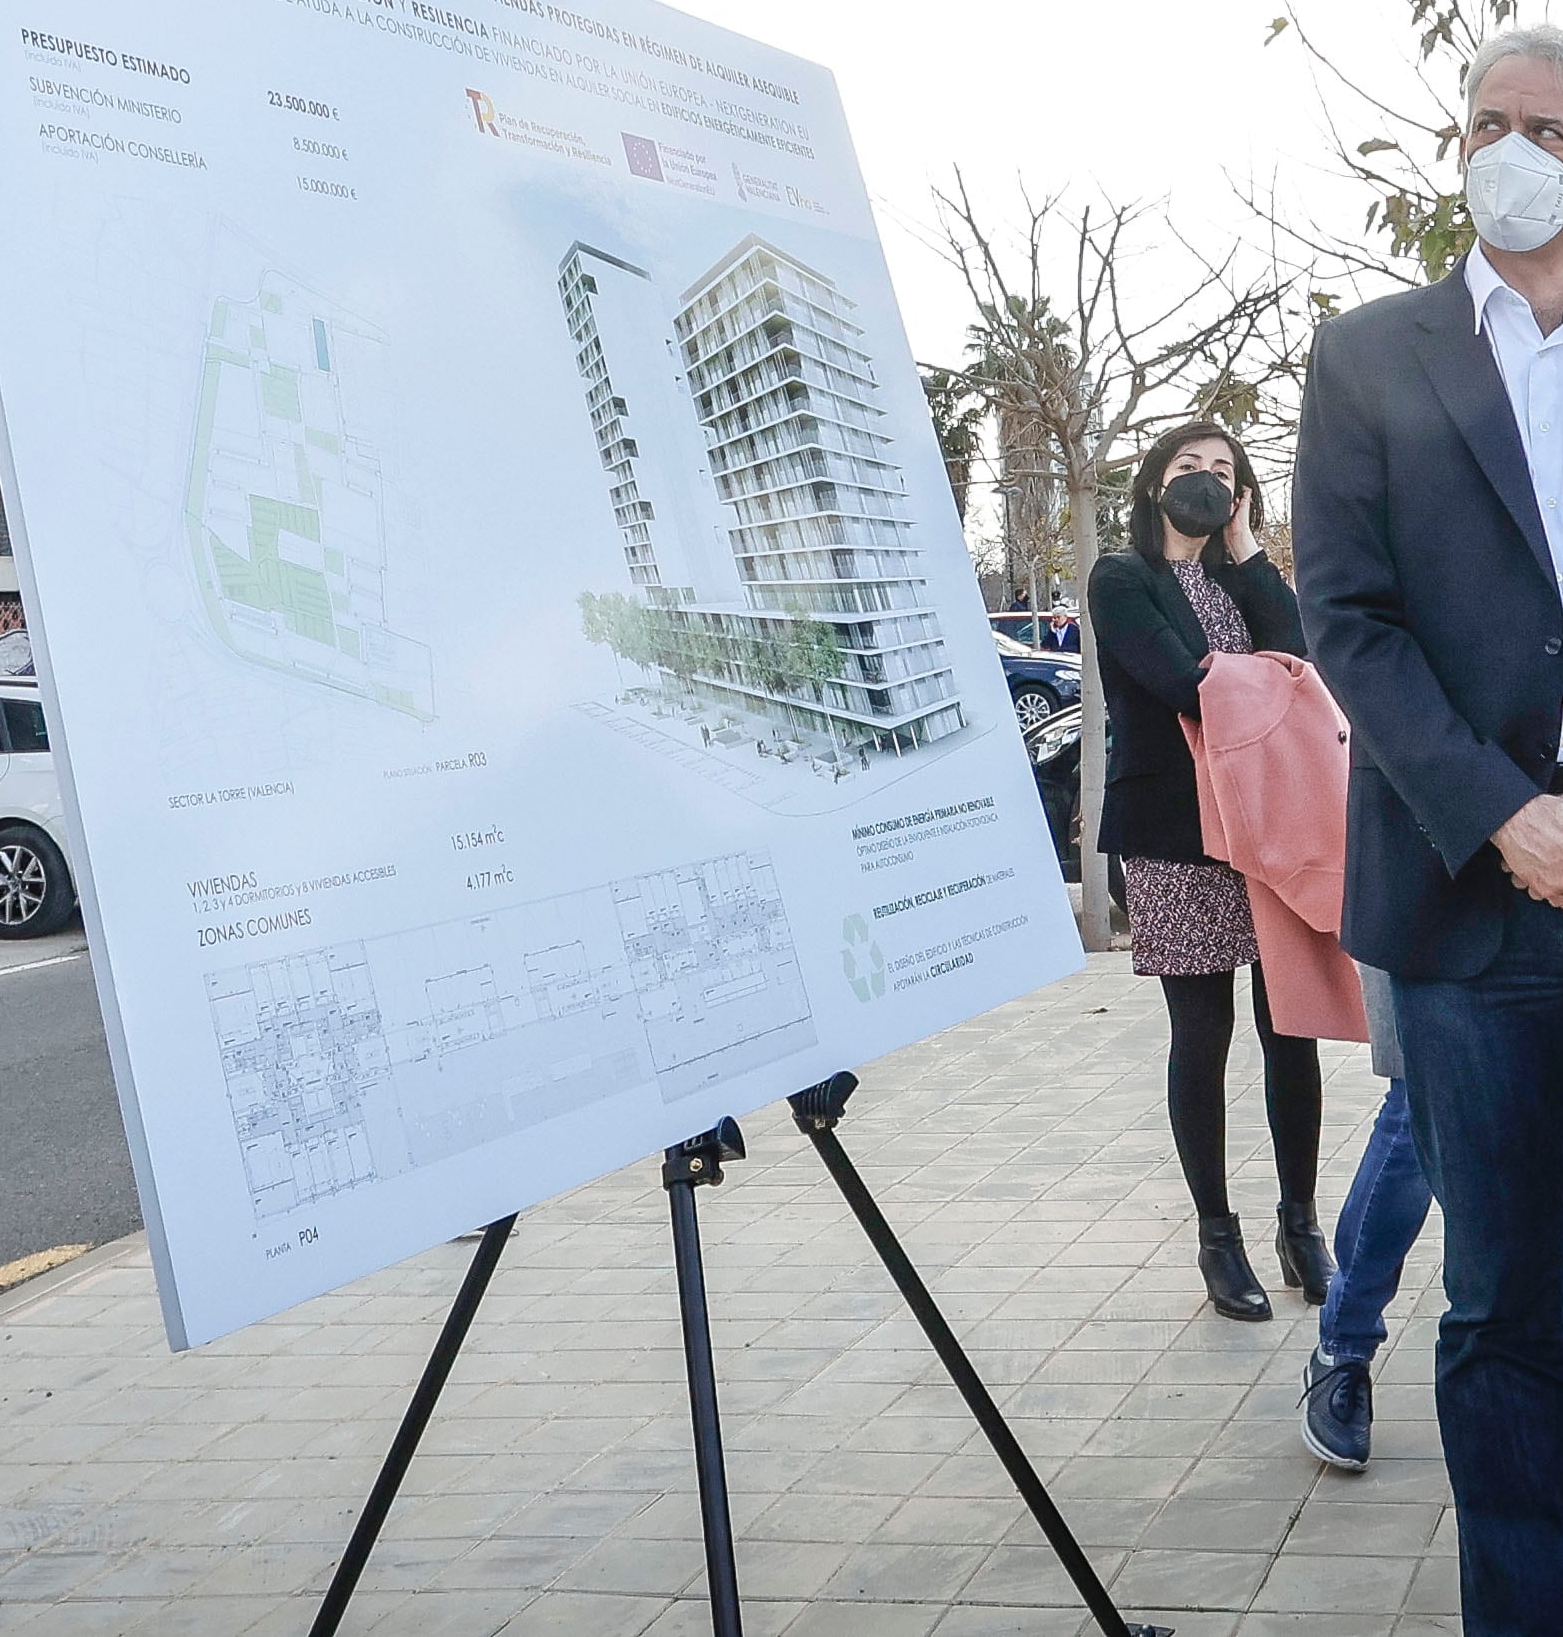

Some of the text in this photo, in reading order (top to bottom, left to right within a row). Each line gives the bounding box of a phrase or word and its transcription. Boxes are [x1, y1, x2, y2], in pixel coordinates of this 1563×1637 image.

[21, 28, 190, 84] PRESUPUESTO ESTIMADO
[411, 0, 489, 40] RESILENCIA
[491, 26, 572, 66] FINANCIADO
[575, 53, 601, 75] POR
[603, 62, 617, 80] LA
[620, 67, 658, 93] UNIÓN
[659, 80, 708, 109] EUROPEA
[715, 99, 796, 137] NEXTGENERATION
[797, 125, 809, 141] EU
[547, 4, 620, 44] PROTEGIDAS
[621, 31, 638, 50] EN
[639, 35, 687, 67] RÉGIMEN
[689, 54, 704, 73] DE
[706, 60, 750, 88] ALQUILER
[752, 77, 800, 105] ASEQUIBLE
[345, 5, 355, 22] A
[356, 8, 374, 28] LA
[376, 14, 473, 57] CONSTRUCCIÓN
[474, 44, 491, 62] DE
[490, 49, 548, 80] VIVIENDAS
[549, 67, 563, 84] EN
[566, 73, 611, 98] ALQUILER
[611, 86, 646, 109] SOCIAL
[647, 98, 661, 113] EN
[660, 102, 703, 126] EDIFICIOS
[703, 115, 776, 148] ENERGÉTICAMENTE
[29, 76, 182, 124] SUBVENCIÓN MINISTERIO
[267, 90, 340, 121] 23.500.000 €
[498, 112, 517, 127] Plan
[519, 118, 529, 131] de
[39, 123, 208, 171] APORTACIÓN CONSELLERÍA
[293, 137, 349, 161] 8.500.000 €
[502, 128, 565, 154] Transformación
[571, 146, 612, 166] Resiliencia
[296, 176, 358, 200] 15.000.000 €
[435, 759, 468, 772] PARCELA
[468, 751, 487, 768] R03
[168, 781, 294, 809] SECTOR LA TORRE (VALENCIA)
[852, 825, 875, 840] MÍNIMO
[875, 818, 905, 834] CONSUMO
[904, 816, 913, 827] DE
[912, 808, 935, 826] ENERGÍA
[958, 803, 967, 813] NO
[966, 796, 995, 812] RENOVABLE
[451, 831, 483, 851] 15.154
[856, 842, 877, 857] ÓPTIMO
[894, 836, 902, 847] DE
[900, 834, 909, 845] LA
[186, 871, 257, 898] VIVIENDAS
[234, 883, 295, 906] DORMITORIOS
[309, 873, 351, 891] VIVIENDAS
[353, 864, 396, 884] ACCESIBLES
[467, 871, 490, 890] 4.177
[914, 888, 944, 906] RECICLAJE
[947, 874, 986, 896] RECUPERACIÓN
[197, 908, 312, 947] ZONAS COMUNES
[887, 963, 895, 973] EL
[894, 954, 915, 971] DISEÑO
[915, 951, 926, 964] DEL
[925, 943, 948, 960] EDIFICIO
[951, 938, 962, 950] LAS
[961, 929, 986, 946] TÉCNICAS
[985, 927, 993, 938] DE
[992, 914, 1029, 936] CONSTRUCCIÓN
[894, 952, 974, 992] APOYARÁN LA CIRCULARIDAD
[266, 1226, 319, 1260] PLANTA P04
